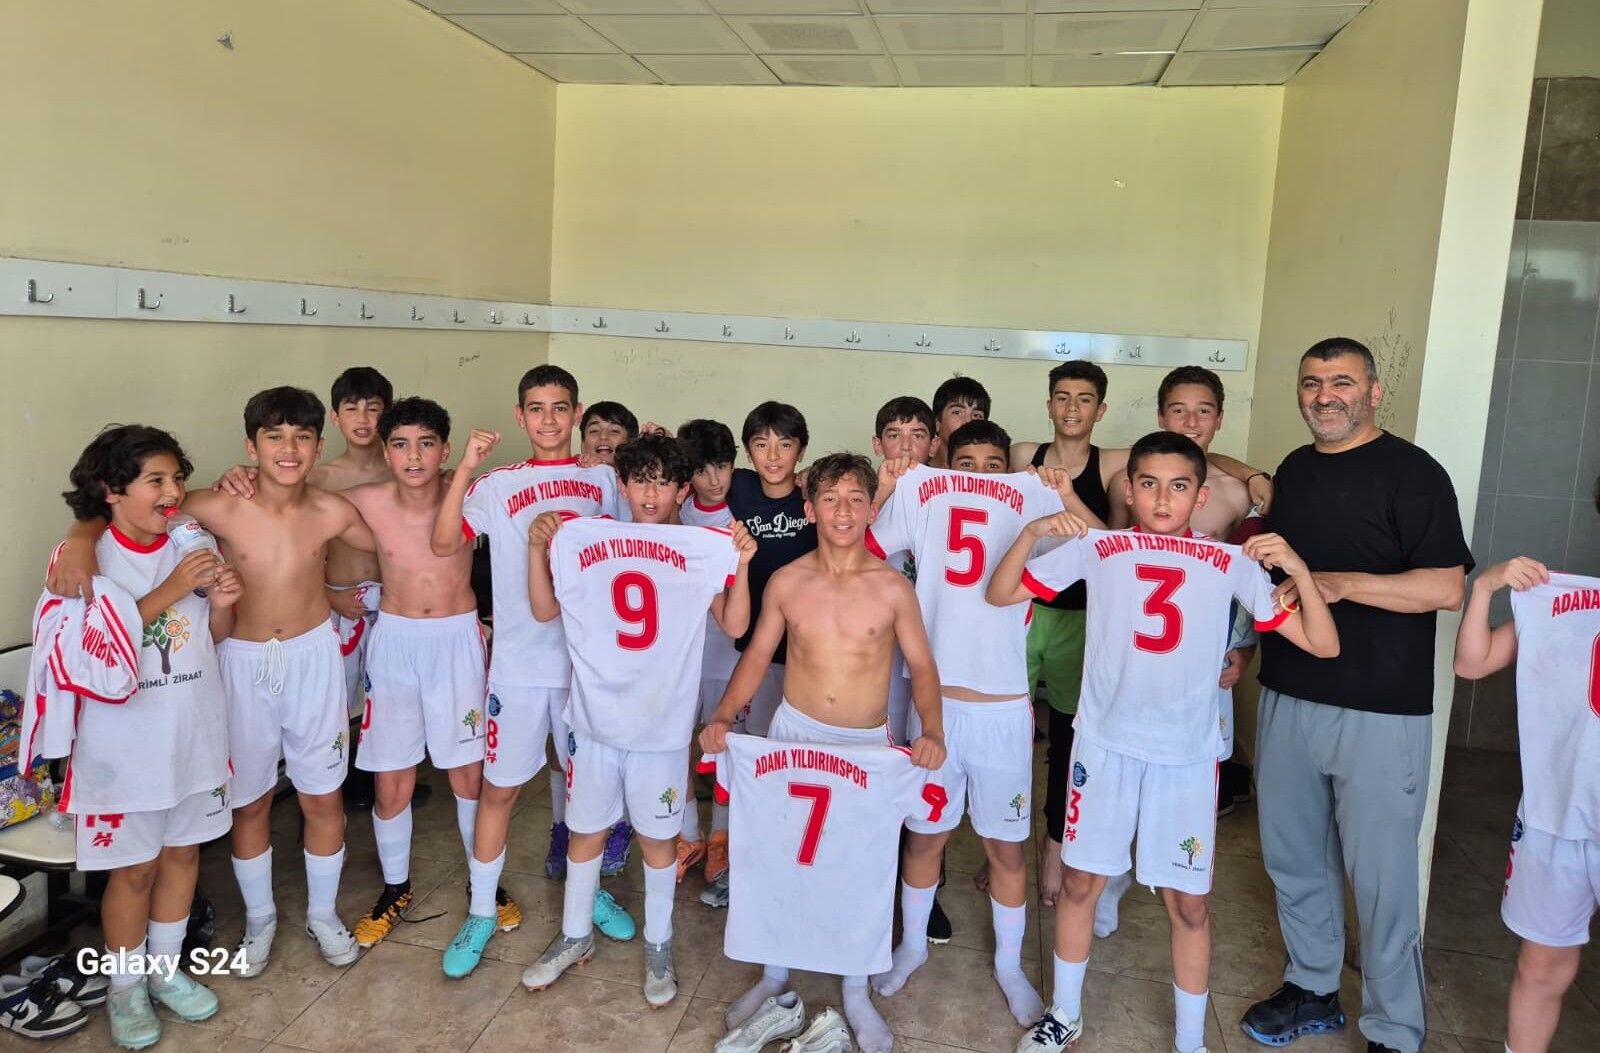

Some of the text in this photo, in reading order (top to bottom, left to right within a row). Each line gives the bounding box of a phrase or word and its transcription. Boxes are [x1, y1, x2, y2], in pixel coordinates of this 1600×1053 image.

[507, 485, 538, 518] ADANA
[918, 475, 1024, 515] ADANA YILDIRIMSPOR
[746, 512, 809, 536] San Diego
[578, 538, 687, 572] ADANA YILDIRIMSPOR
[945, 506, 988, 587] 5
[1094, 534, 1231, 574] ADANA YILDIRIMSPOR
[611, 570, 659, 651] 9
[1134, 563, 1186, 654] 3
[1551, 589, 1600, 618] ADANA
[138, 674, 168, 690] RİMLİ
[487, 718, 498, 749] 8
[755, 748, 868, 789] ADANA YILDIRIMSPOR
[787, 781, 832, 866] 7
[1066, 788, 1082, 824] 3
